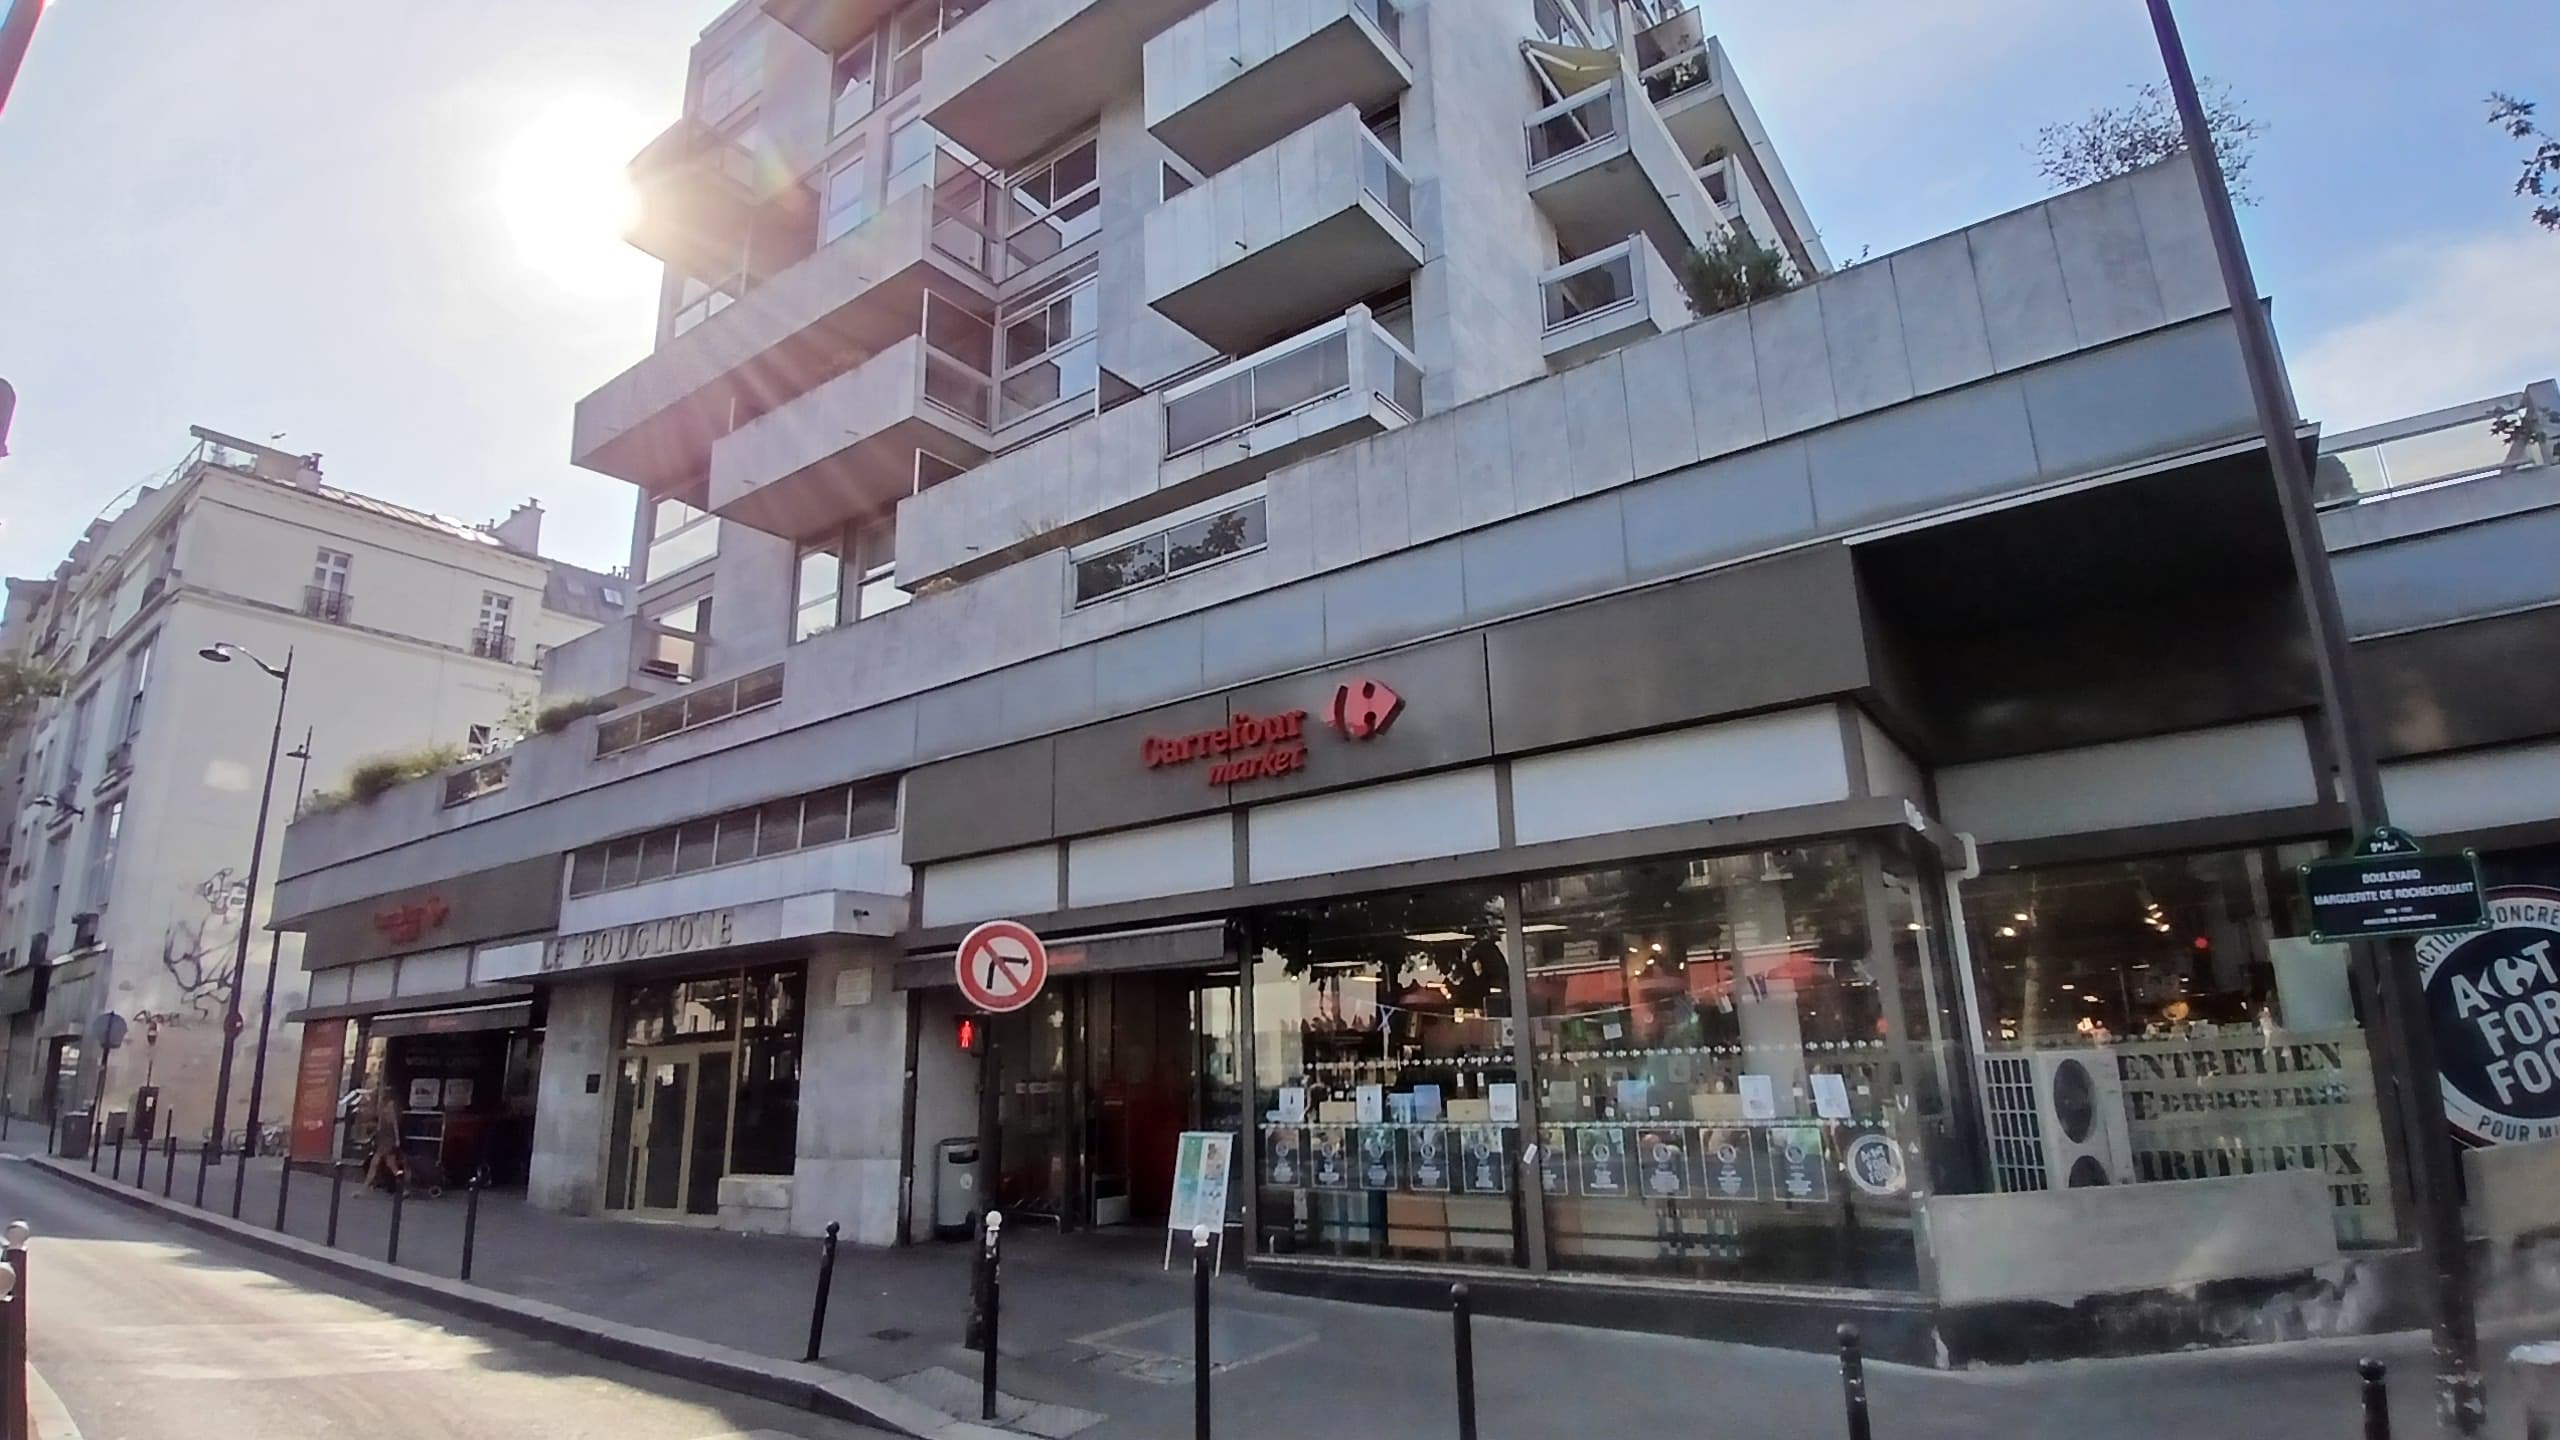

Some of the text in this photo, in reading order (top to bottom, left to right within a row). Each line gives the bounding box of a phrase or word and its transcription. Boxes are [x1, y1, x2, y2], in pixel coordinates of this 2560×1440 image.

[1141, 709, 1307, 769] Carrefour
[1208, 742, 1307, 786] market
[2314, 882, 2474, 905] MARGUERITE DE ROCHECHOUART
[2362, 868, 2421, 884] BOULEVARD
[541, 912, 732, 971] LE BOUGLIONE
[2117, 1041, 2343, 1081] ENTRETIEN
[2477, 1114, 2530, 1142] POUR
